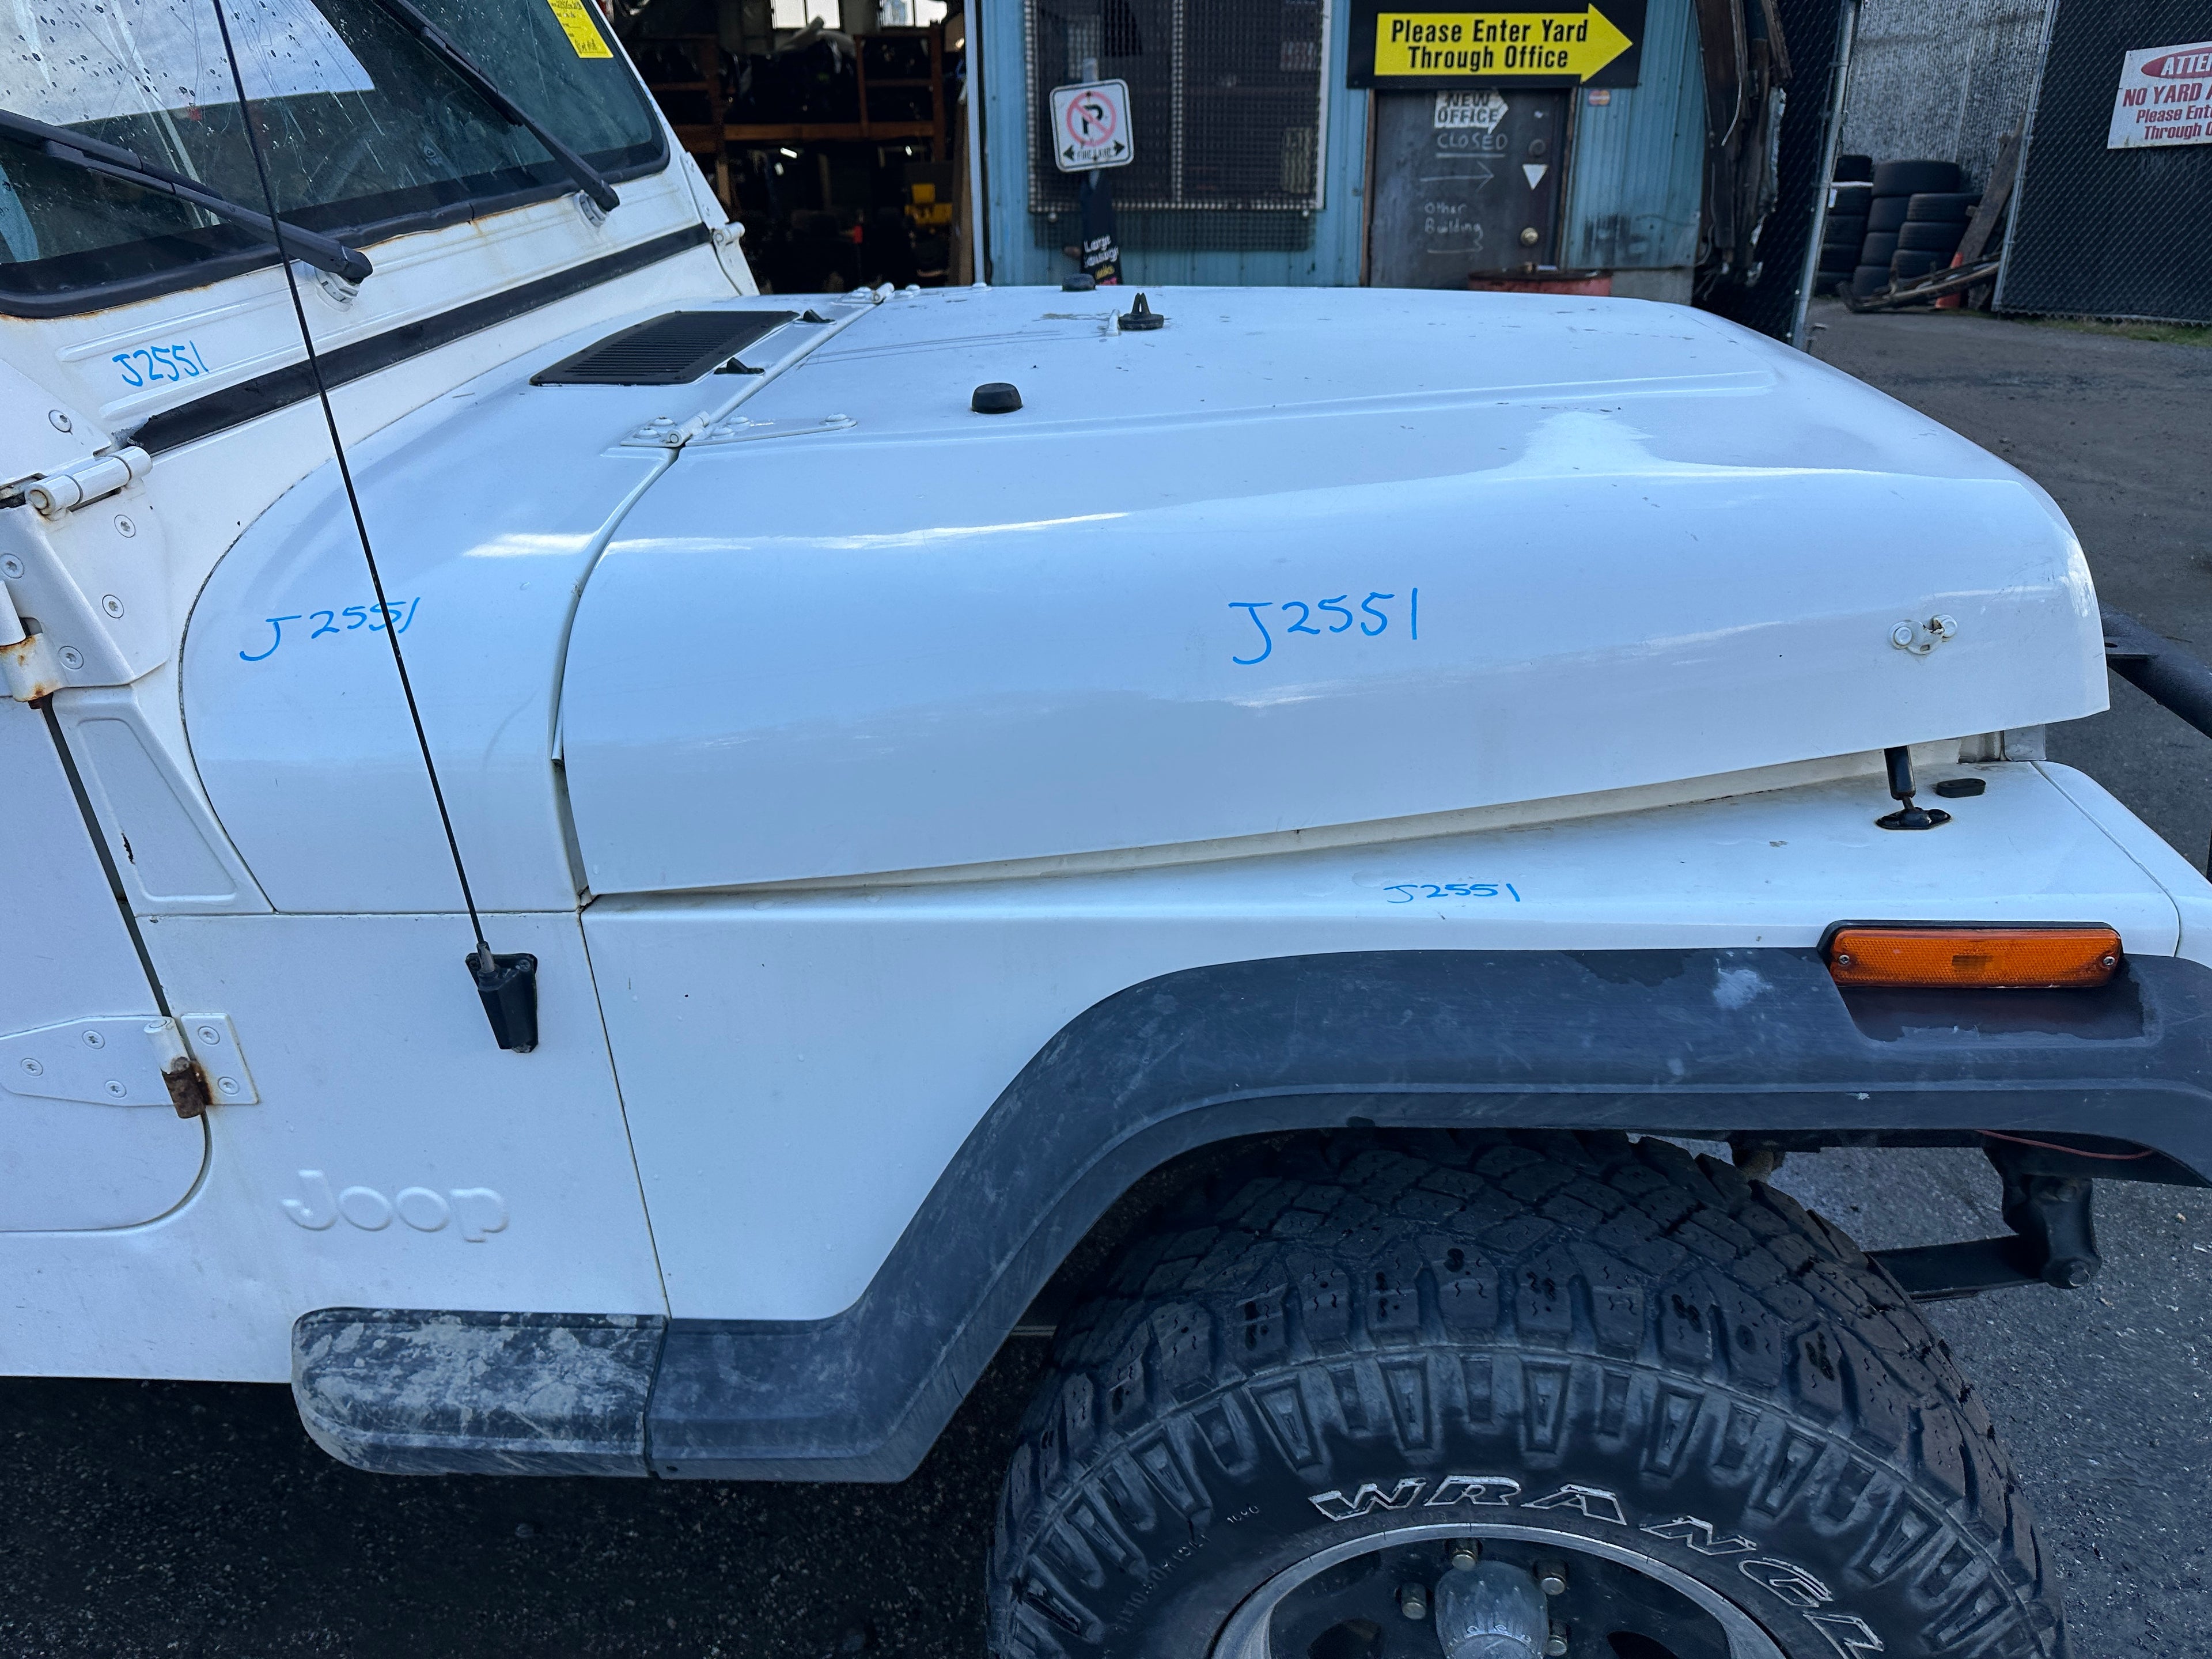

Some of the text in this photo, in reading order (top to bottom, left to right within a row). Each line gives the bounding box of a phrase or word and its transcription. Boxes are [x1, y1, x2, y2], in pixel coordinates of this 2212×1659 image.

[1392, 19, 1588, 42] Please Enter Yard
[1408, 45, 1568, 72] Through Office
[2161, 52, 2212, 75] ATTE
[1445, 92, 1488, 106] NEW
[2123, 88, 2147, 107] NO
[2154, 82, 2202, 104] YARD
[1438, 108, 1498, 123] OFFICE
[2136, 109, 2183, 123] Please
[1437, 132, 1508, 150] CLOSED
[2145, 122, 2202, 140] Through
[112, 340, 209, 387] J2551
[239, 597, 421, 661] J2551
[1228, 588, 1418, 665] J2551
[1382, 883, 1521, 903] J2551
